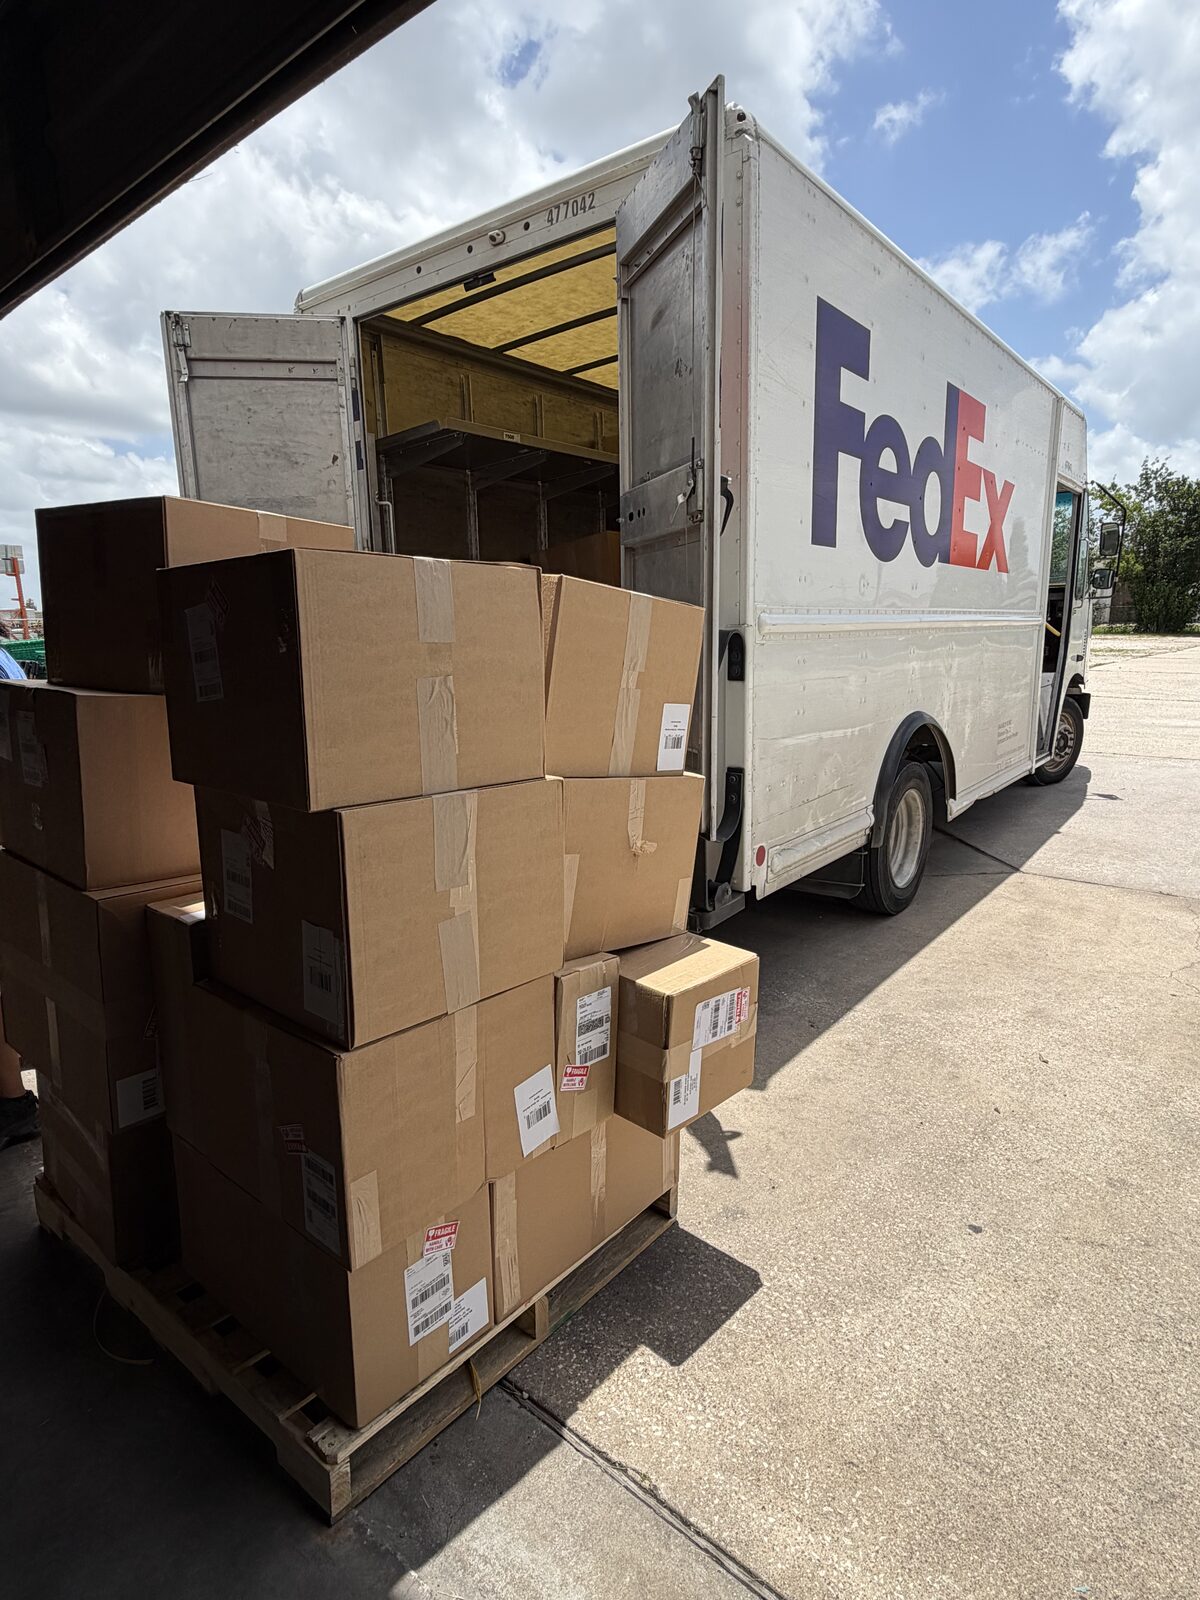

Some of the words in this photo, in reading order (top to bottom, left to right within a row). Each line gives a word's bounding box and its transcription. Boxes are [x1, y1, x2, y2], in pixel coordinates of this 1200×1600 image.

[546, 192, 596, 226] 477042
[811, 296, 1015, 574] FedEx
[435, 1225, 456, 1237] FRAGILE
